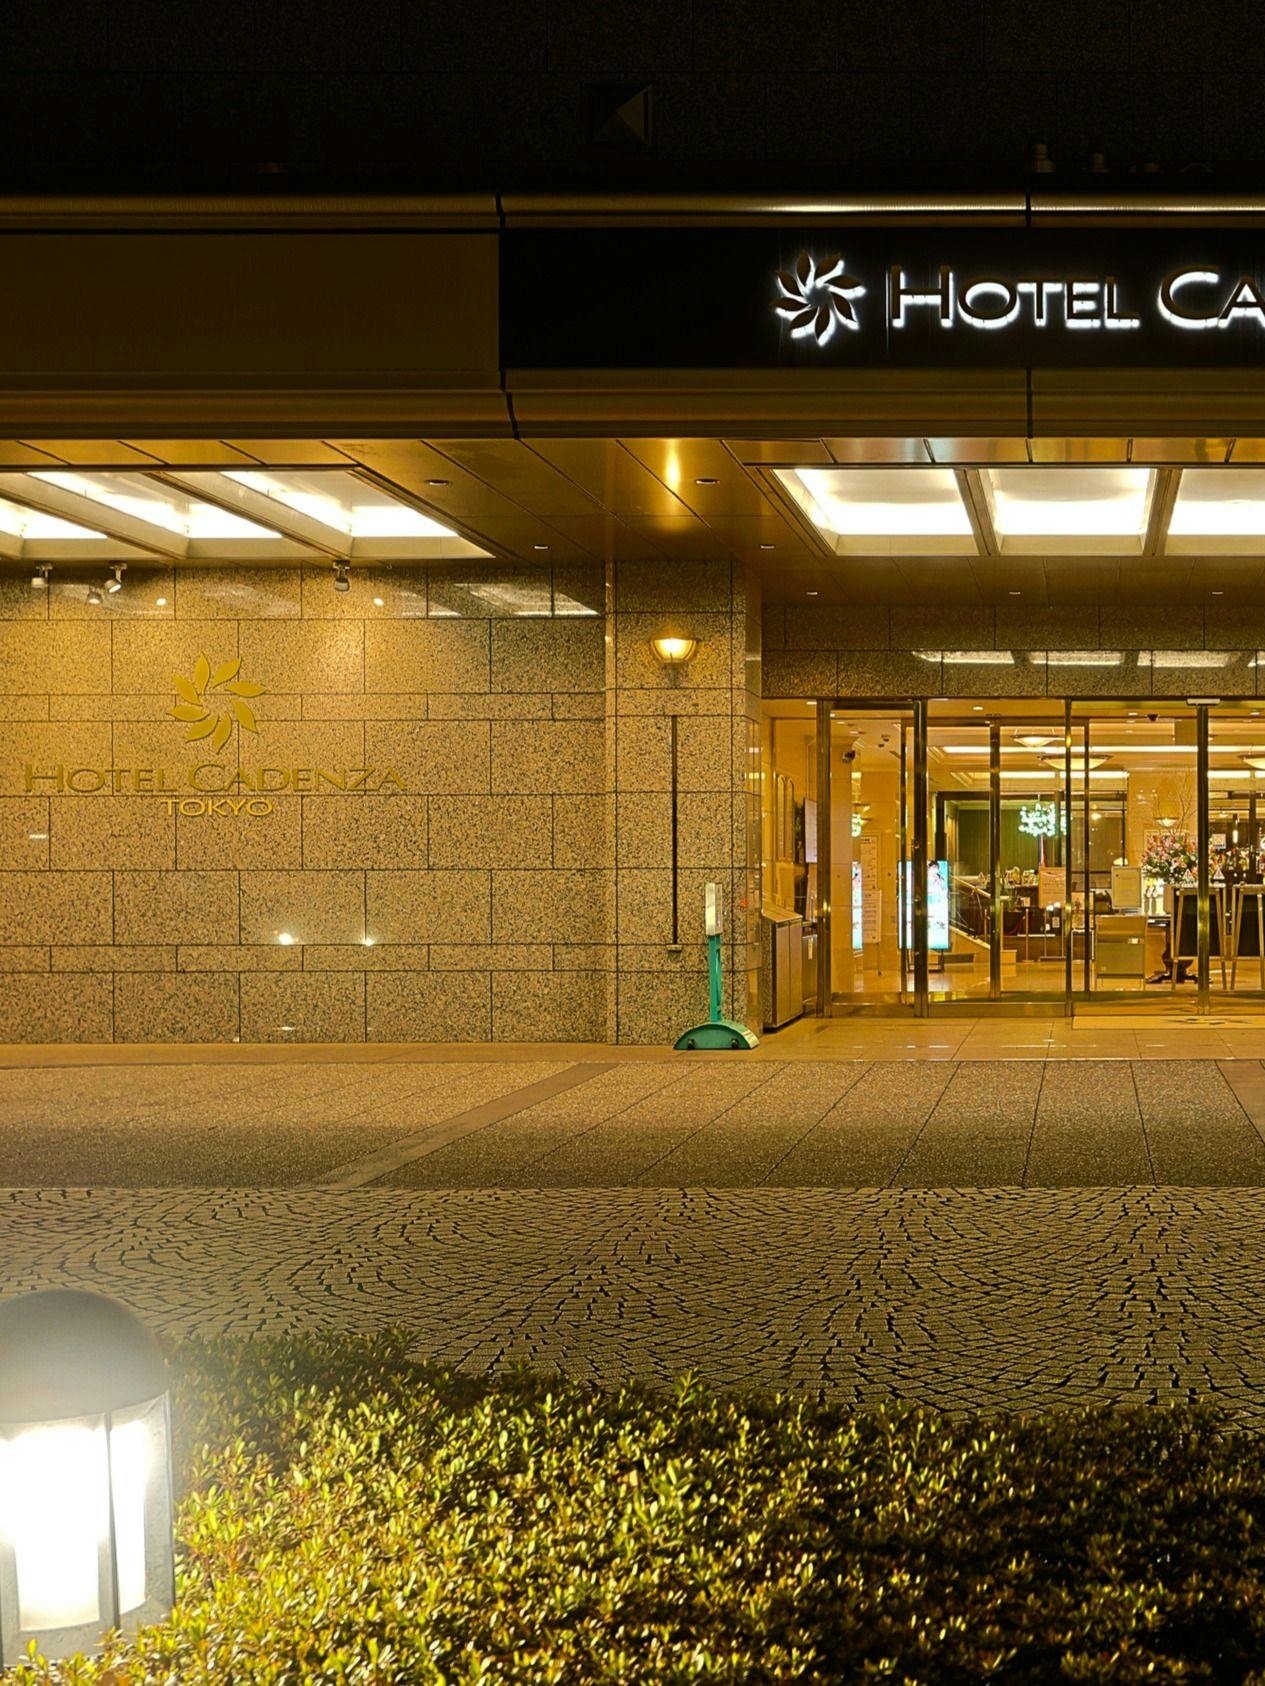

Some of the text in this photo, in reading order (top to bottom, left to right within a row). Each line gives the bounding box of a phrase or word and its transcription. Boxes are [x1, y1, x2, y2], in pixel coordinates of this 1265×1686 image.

[891, 265, 1140, 328] HOTEL
[24, 763, 407, 793] HOTEL CADENZA
[162, 799, 273, 817] TOKYO
